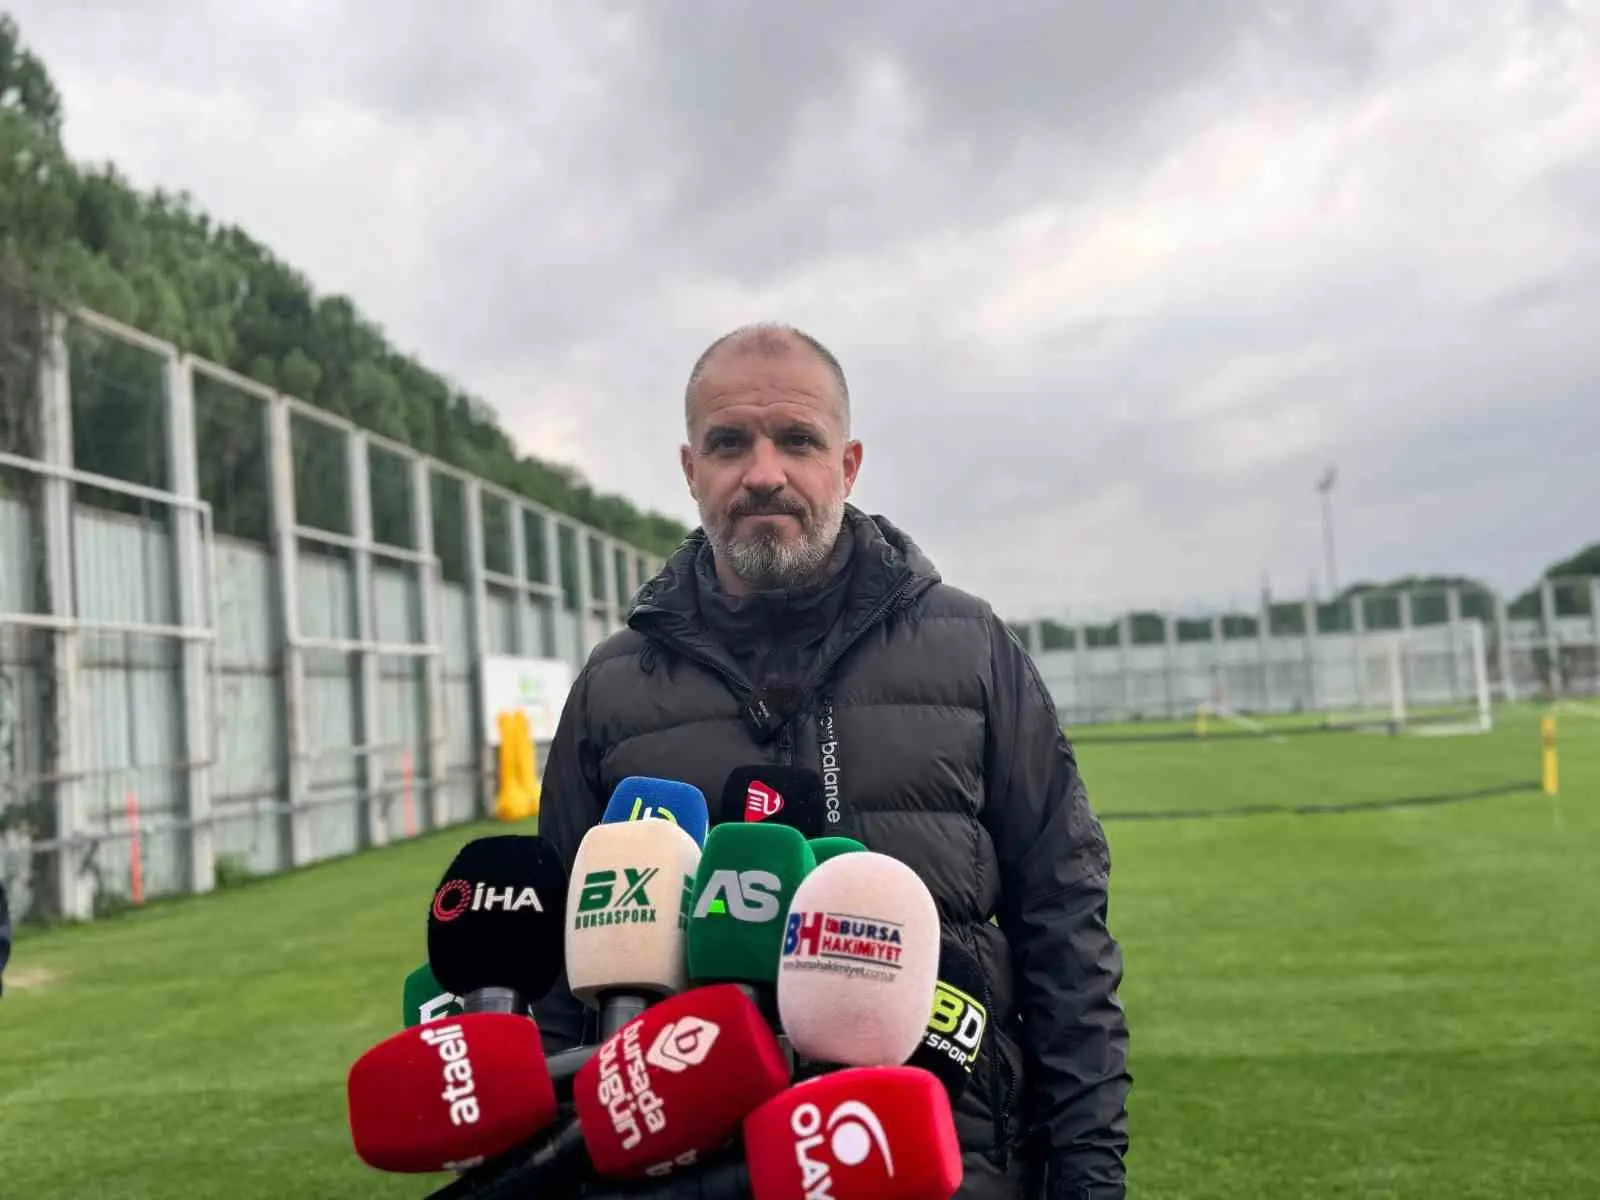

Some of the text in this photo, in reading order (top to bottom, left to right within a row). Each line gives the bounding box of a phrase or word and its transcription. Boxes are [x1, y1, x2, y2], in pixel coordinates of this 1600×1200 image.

[822, 741, 841, 824] balance
[692, 869, 782, 923] AS
[783, 911, 824, 957] BH
[839, 919, 902, 944] BURSA
[926, 1032, 968, 1066] SPOR
[623, 1019, 667, 1134] bursada
